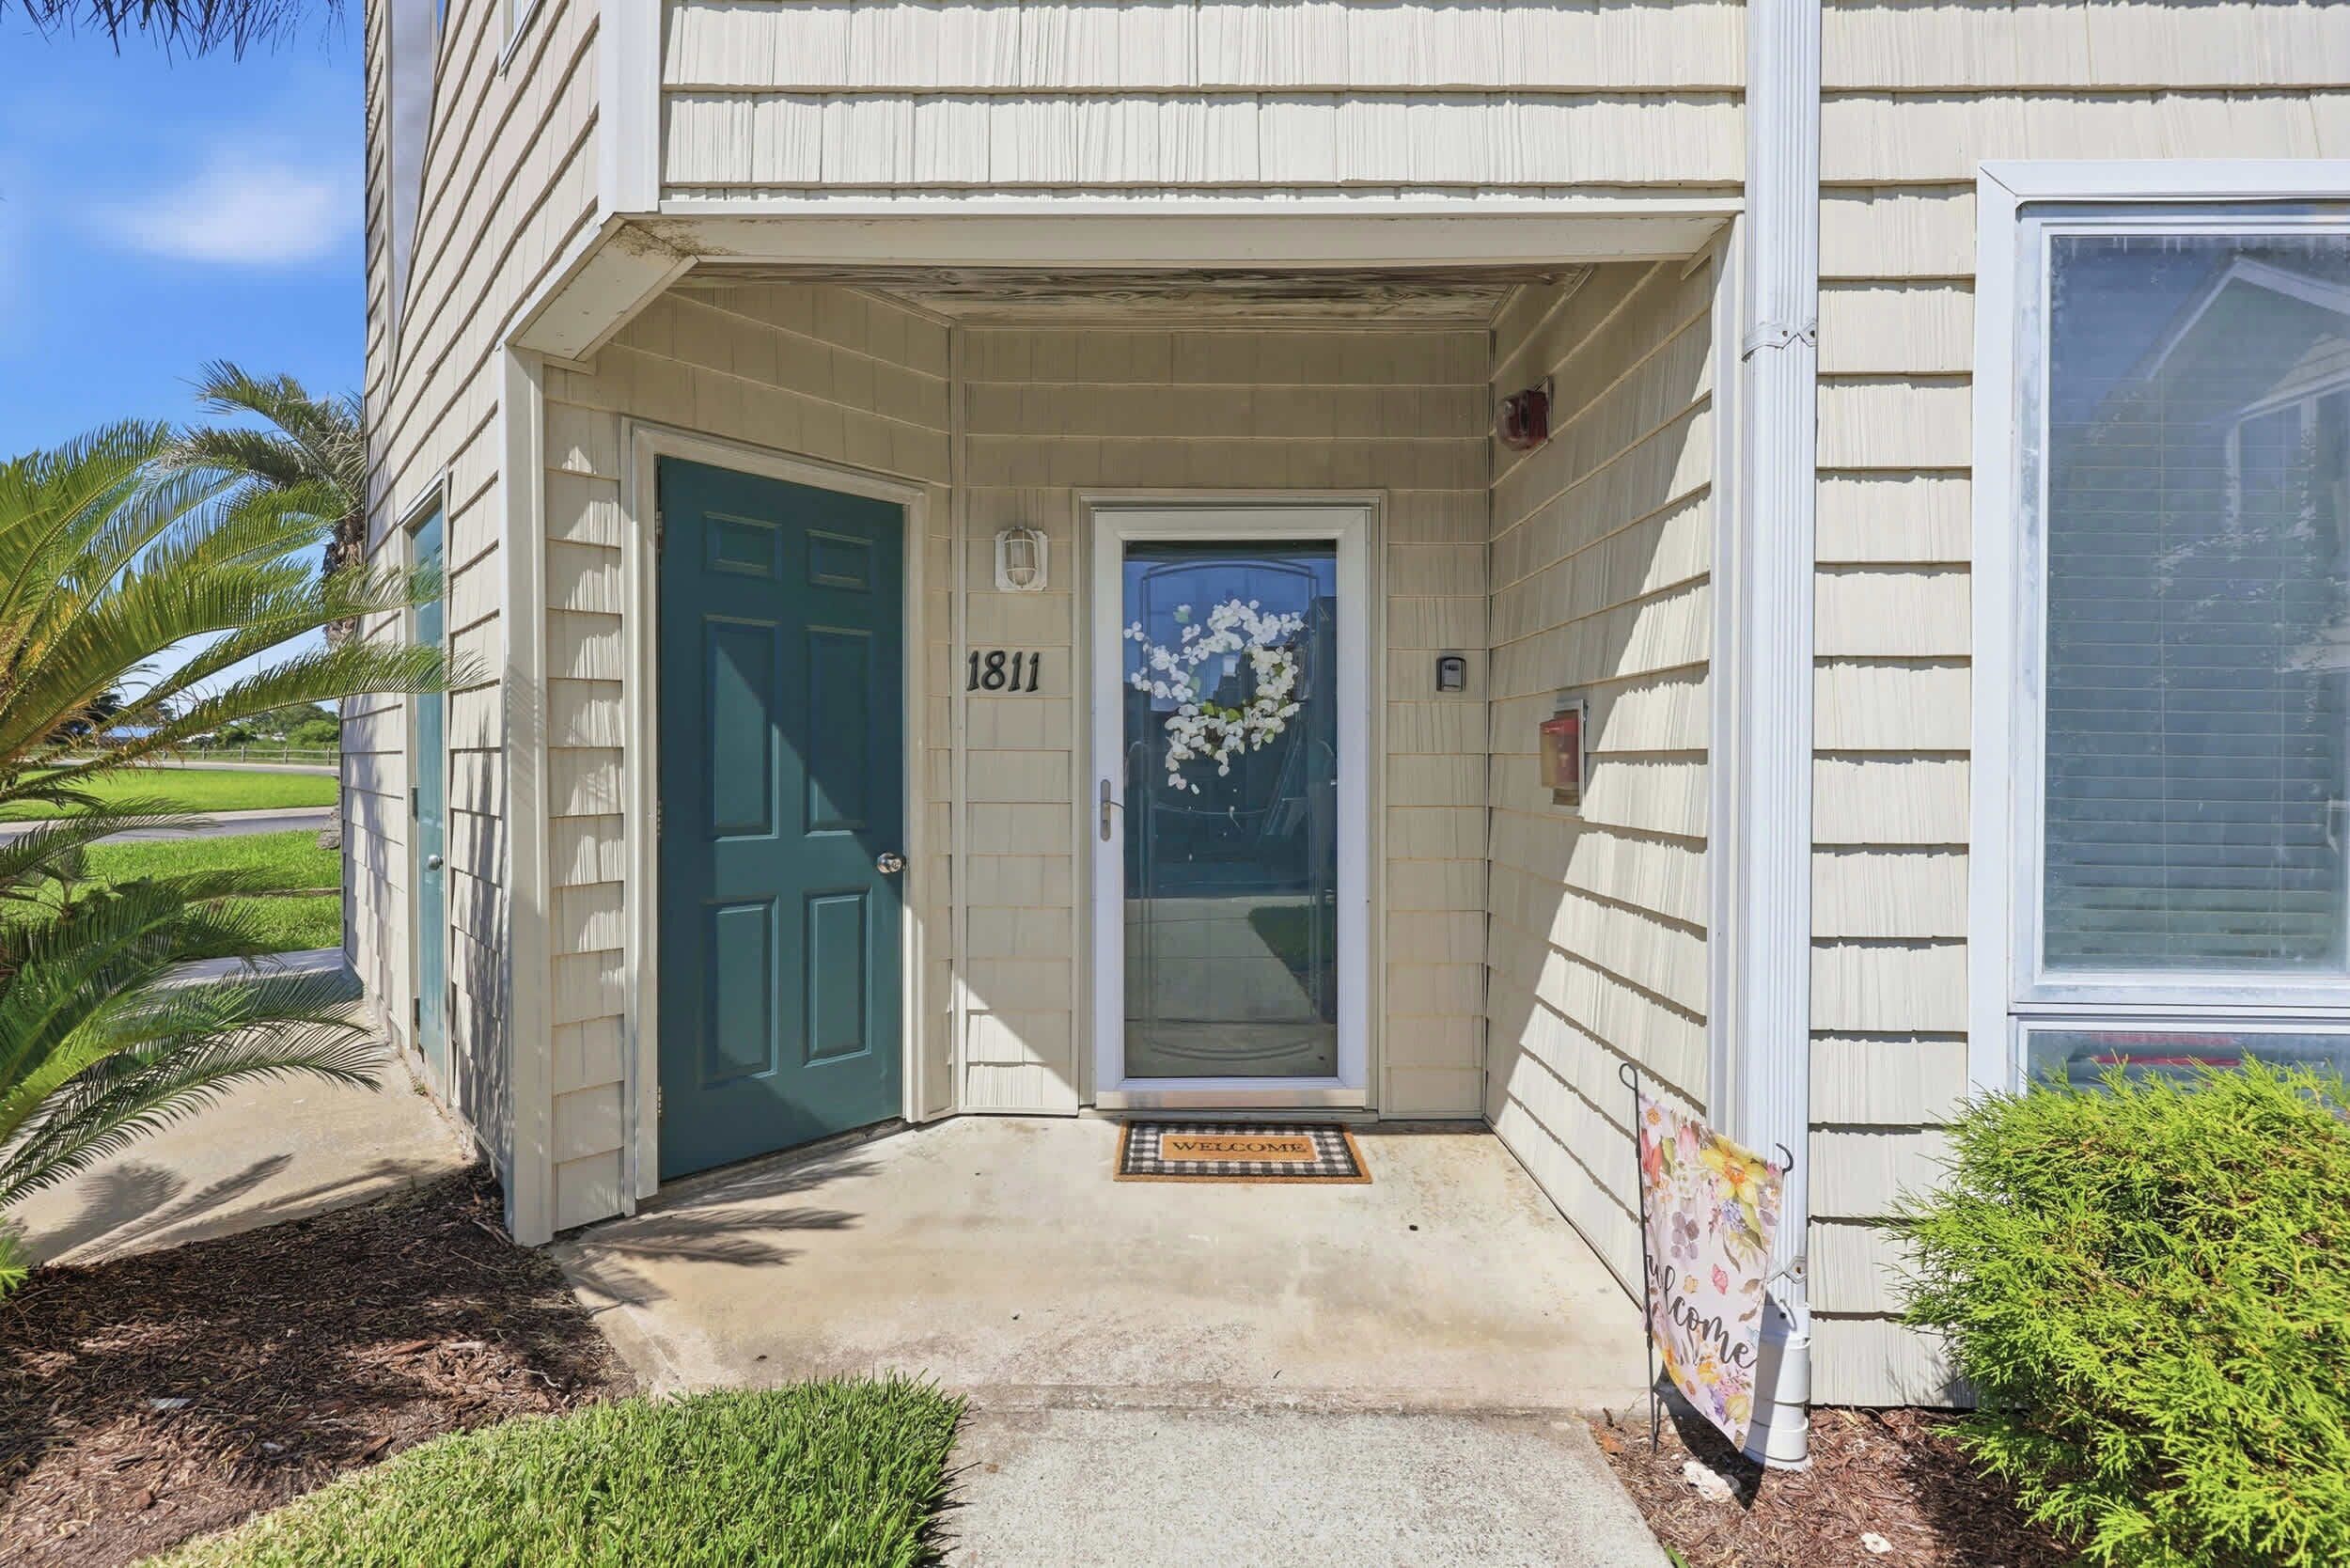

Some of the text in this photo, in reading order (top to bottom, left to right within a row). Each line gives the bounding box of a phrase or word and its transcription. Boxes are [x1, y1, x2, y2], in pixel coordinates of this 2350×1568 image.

[966, 650, 1040, 693] 1811
[1172, 1141, 1308, 1153] WELCOME
[1647, 1254, 1758, 1369] lcome
